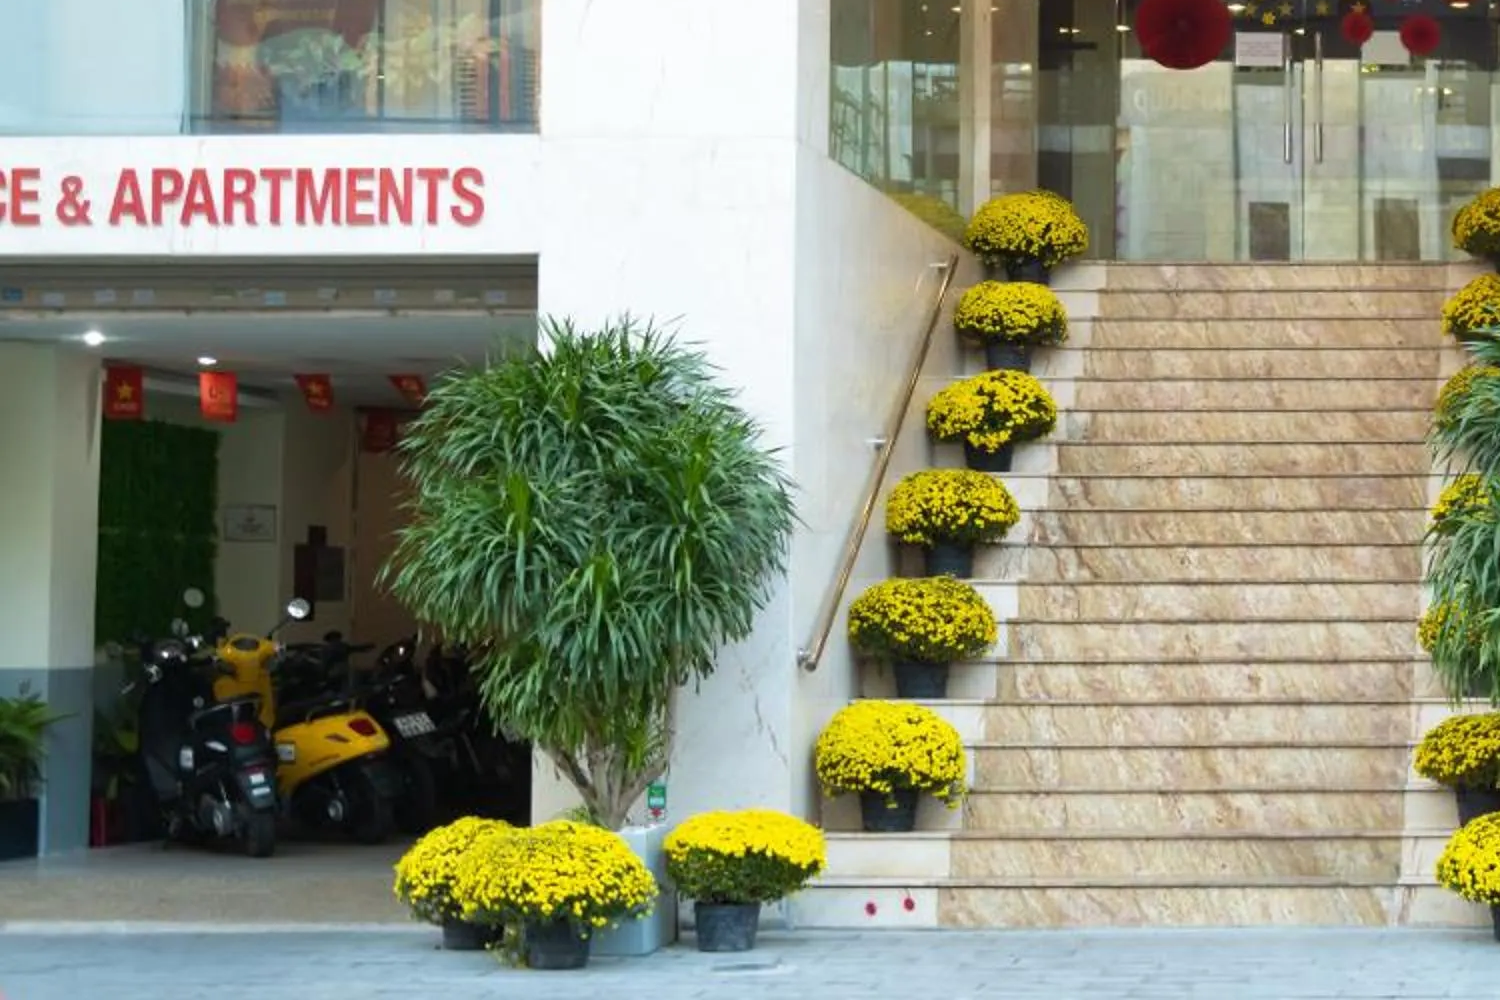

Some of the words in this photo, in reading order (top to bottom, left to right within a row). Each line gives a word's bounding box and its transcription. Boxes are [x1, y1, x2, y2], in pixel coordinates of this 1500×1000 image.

[0, 168, 41, 225] E
[56, 175, 92, 225] &
[109, 167, 486, 227] APARTMENTS
